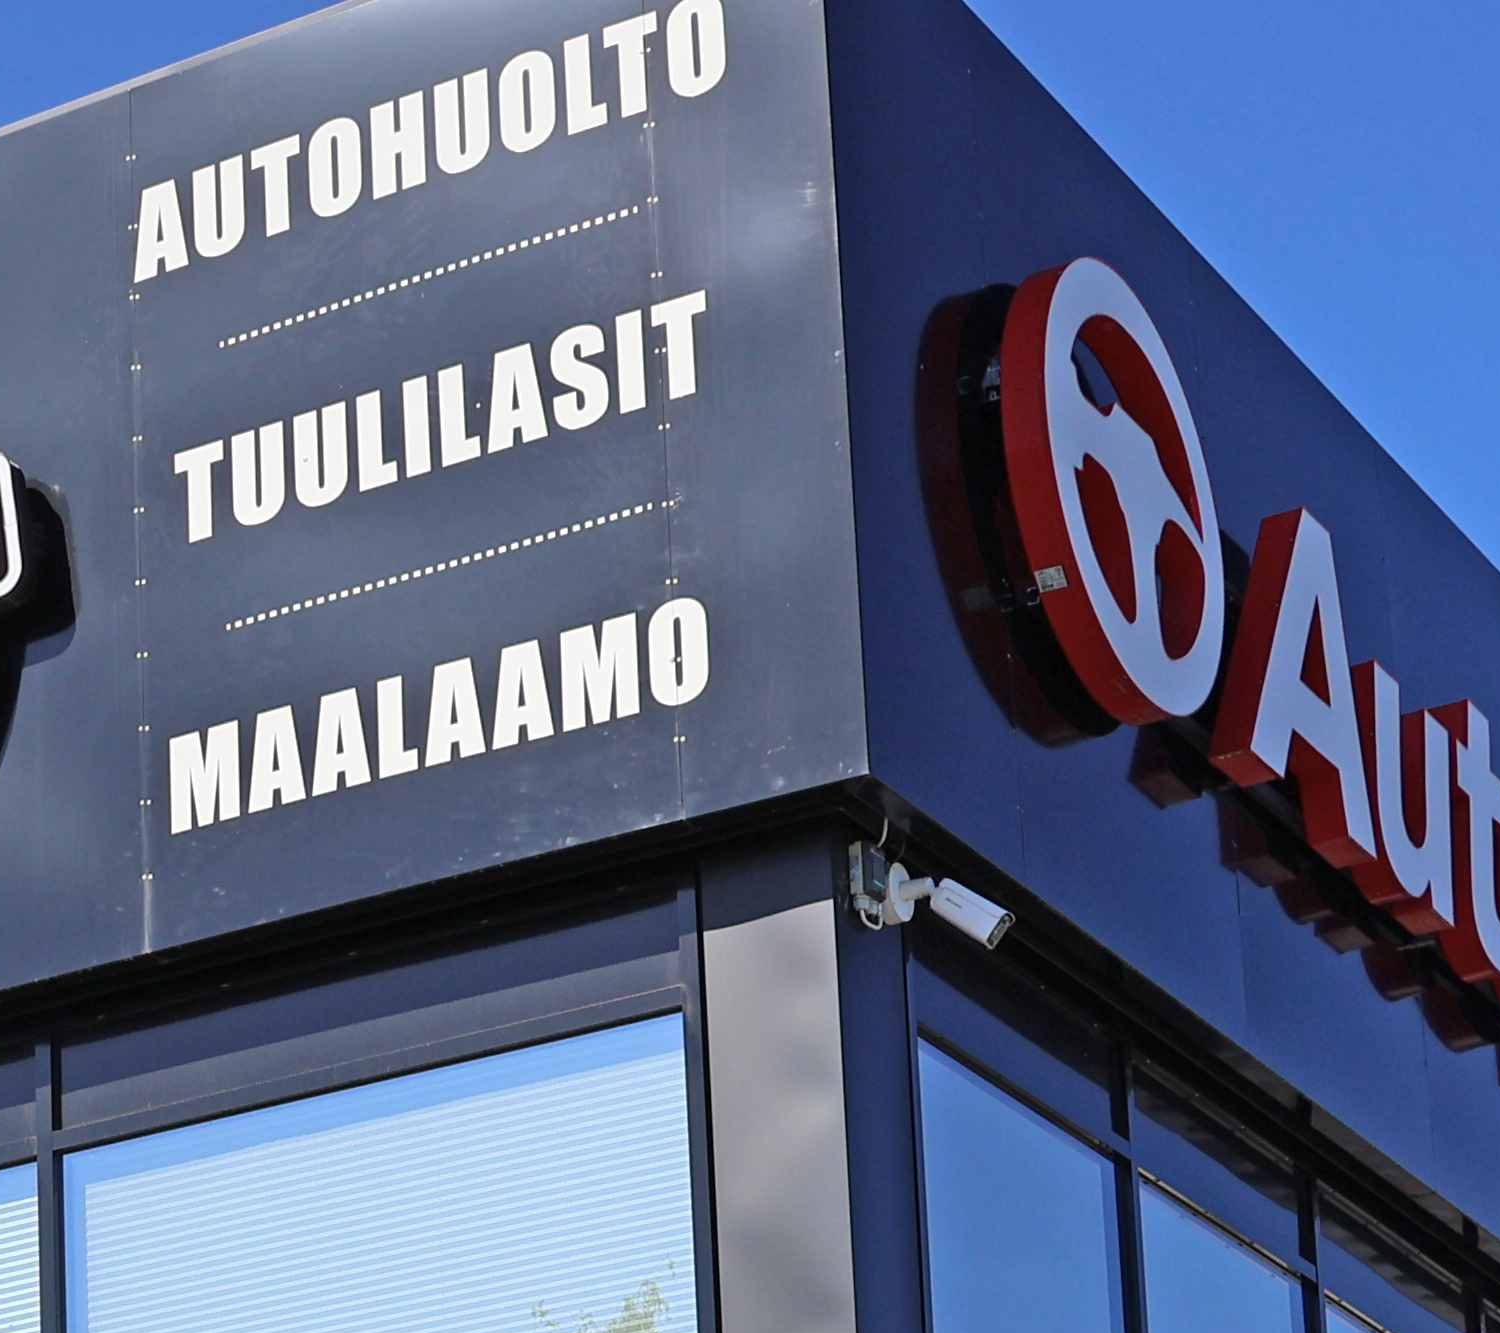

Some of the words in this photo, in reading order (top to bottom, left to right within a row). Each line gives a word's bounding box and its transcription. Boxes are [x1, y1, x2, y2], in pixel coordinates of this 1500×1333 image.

[132, 0, 727, 283] AUTOHUOLTO
[173, 290, 708, 543] TUULILASIT
[168, 597, 710, 836] MAALAAMO
